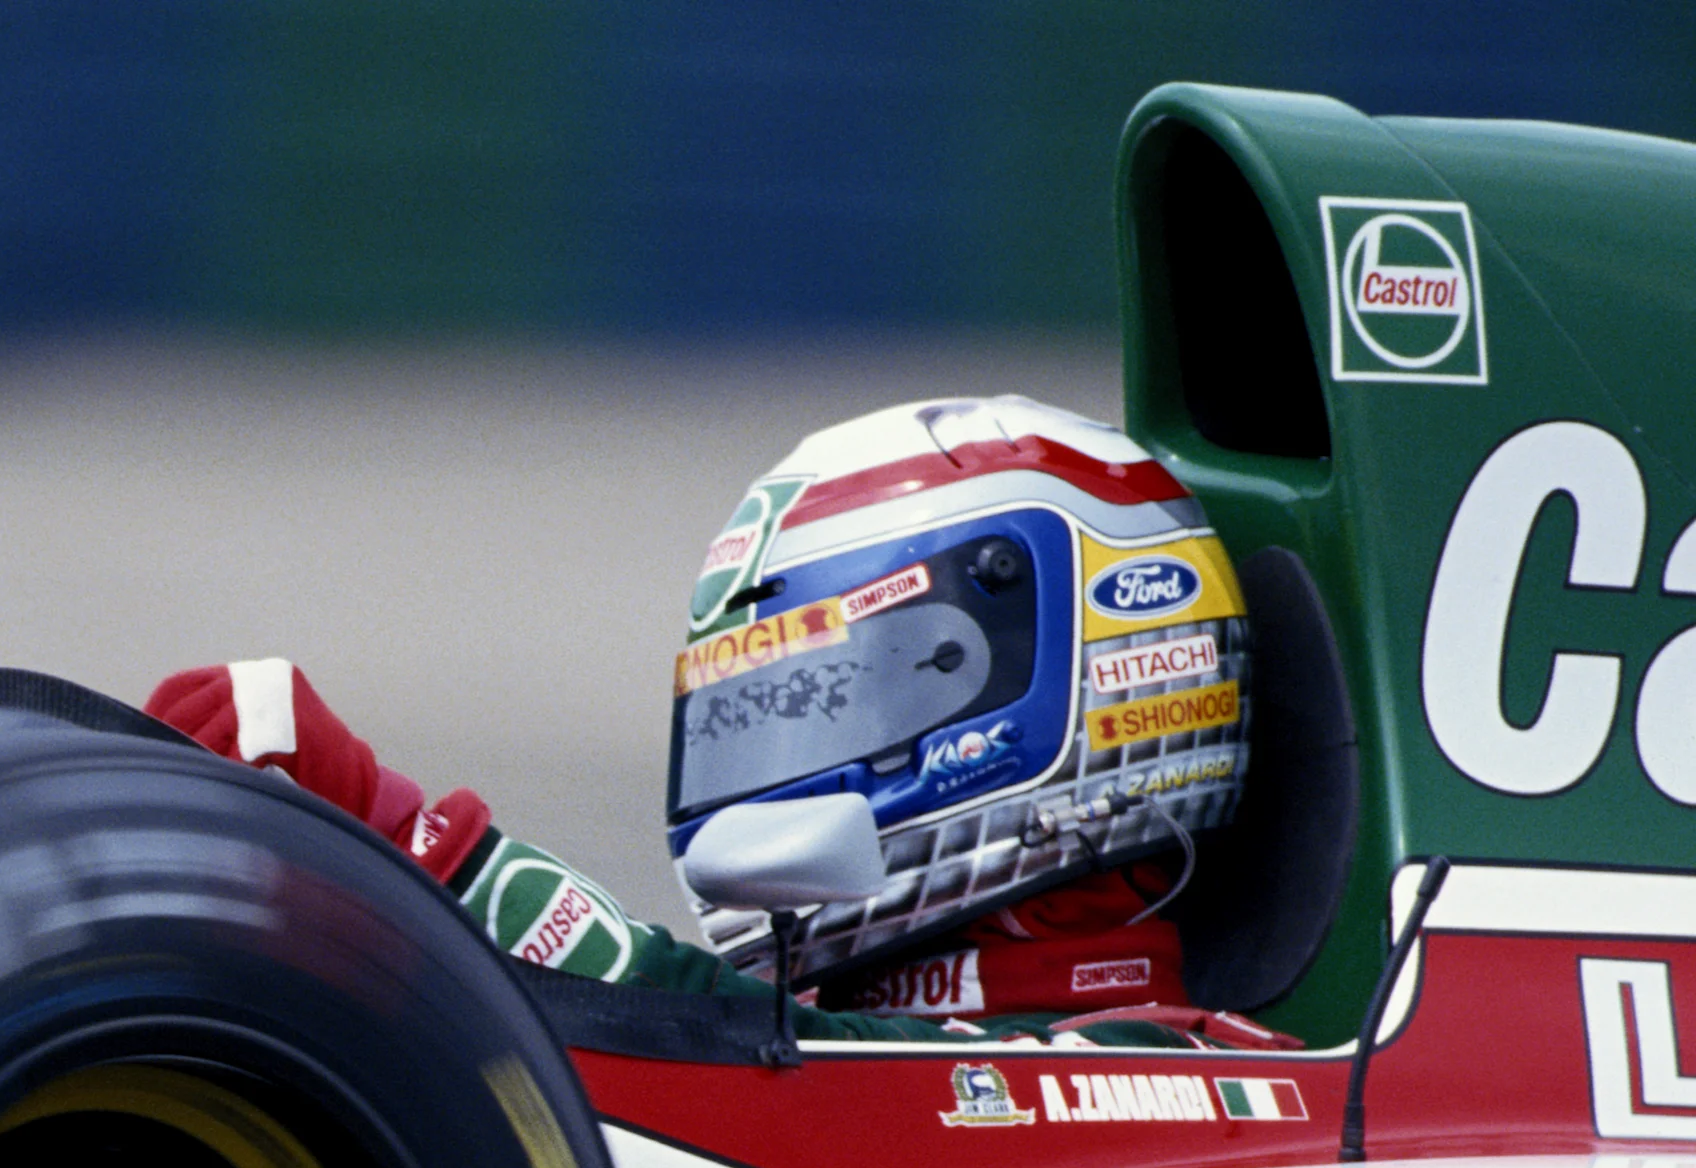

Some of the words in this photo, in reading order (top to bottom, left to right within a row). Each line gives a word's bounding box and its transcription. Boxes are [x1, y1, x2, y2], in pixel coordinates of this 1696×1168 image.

[1363, 271, 1458, 308] Castrol
[847, 572, 921, 617] SIMPSON
[1113, 564, 1182, 608] Ford
[1095, 641, 1216, 687] HITACHI
[1122, 689, 1235, 736] SHIONOGI
[522, 888, 592, 966] Castro
[1074, 963, 1148, 989] SIMPSON
